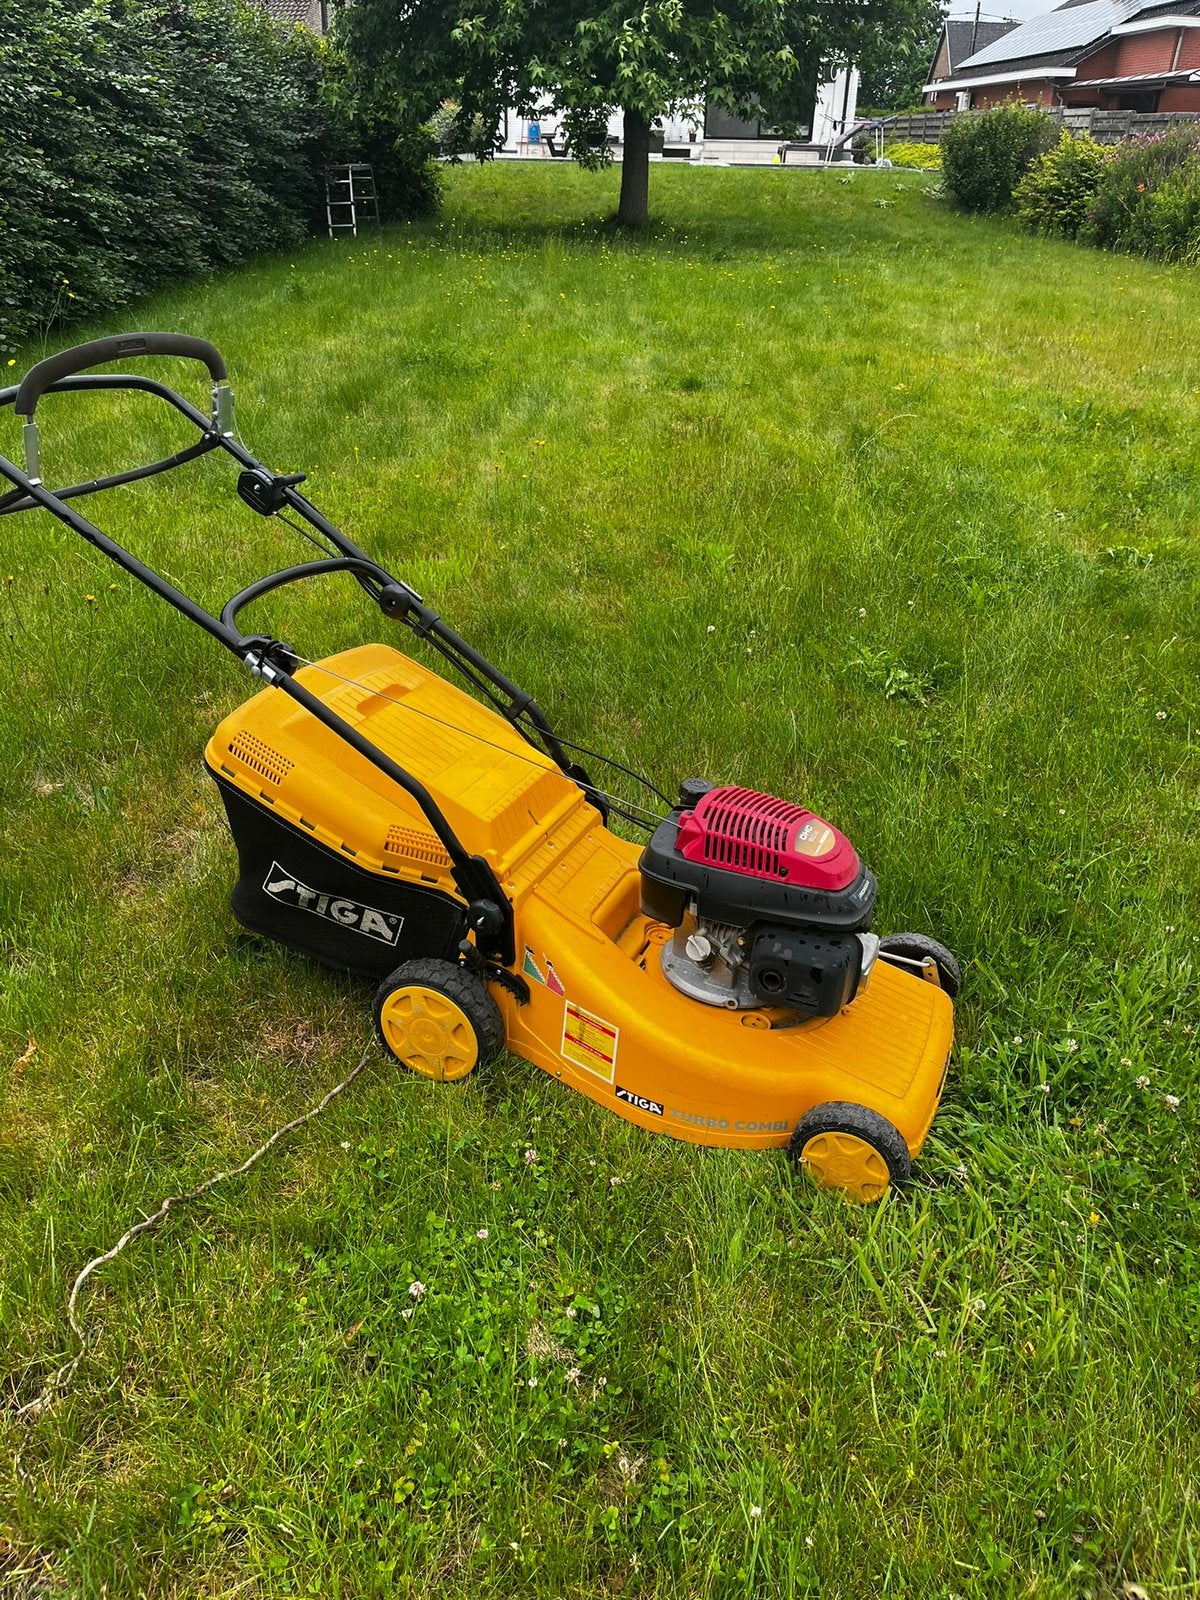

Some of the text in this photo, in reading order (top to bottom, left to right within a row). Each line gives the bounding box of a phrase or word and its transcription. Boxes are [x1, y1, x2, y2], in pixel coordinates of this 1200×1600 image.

[799, 824, 813, 841] OHC
[267, 879, 394, 941] STIGA
[616, 1089, 662, 1115] STIGA
[670, 1108, 789, 1132] TURBO COMBI
